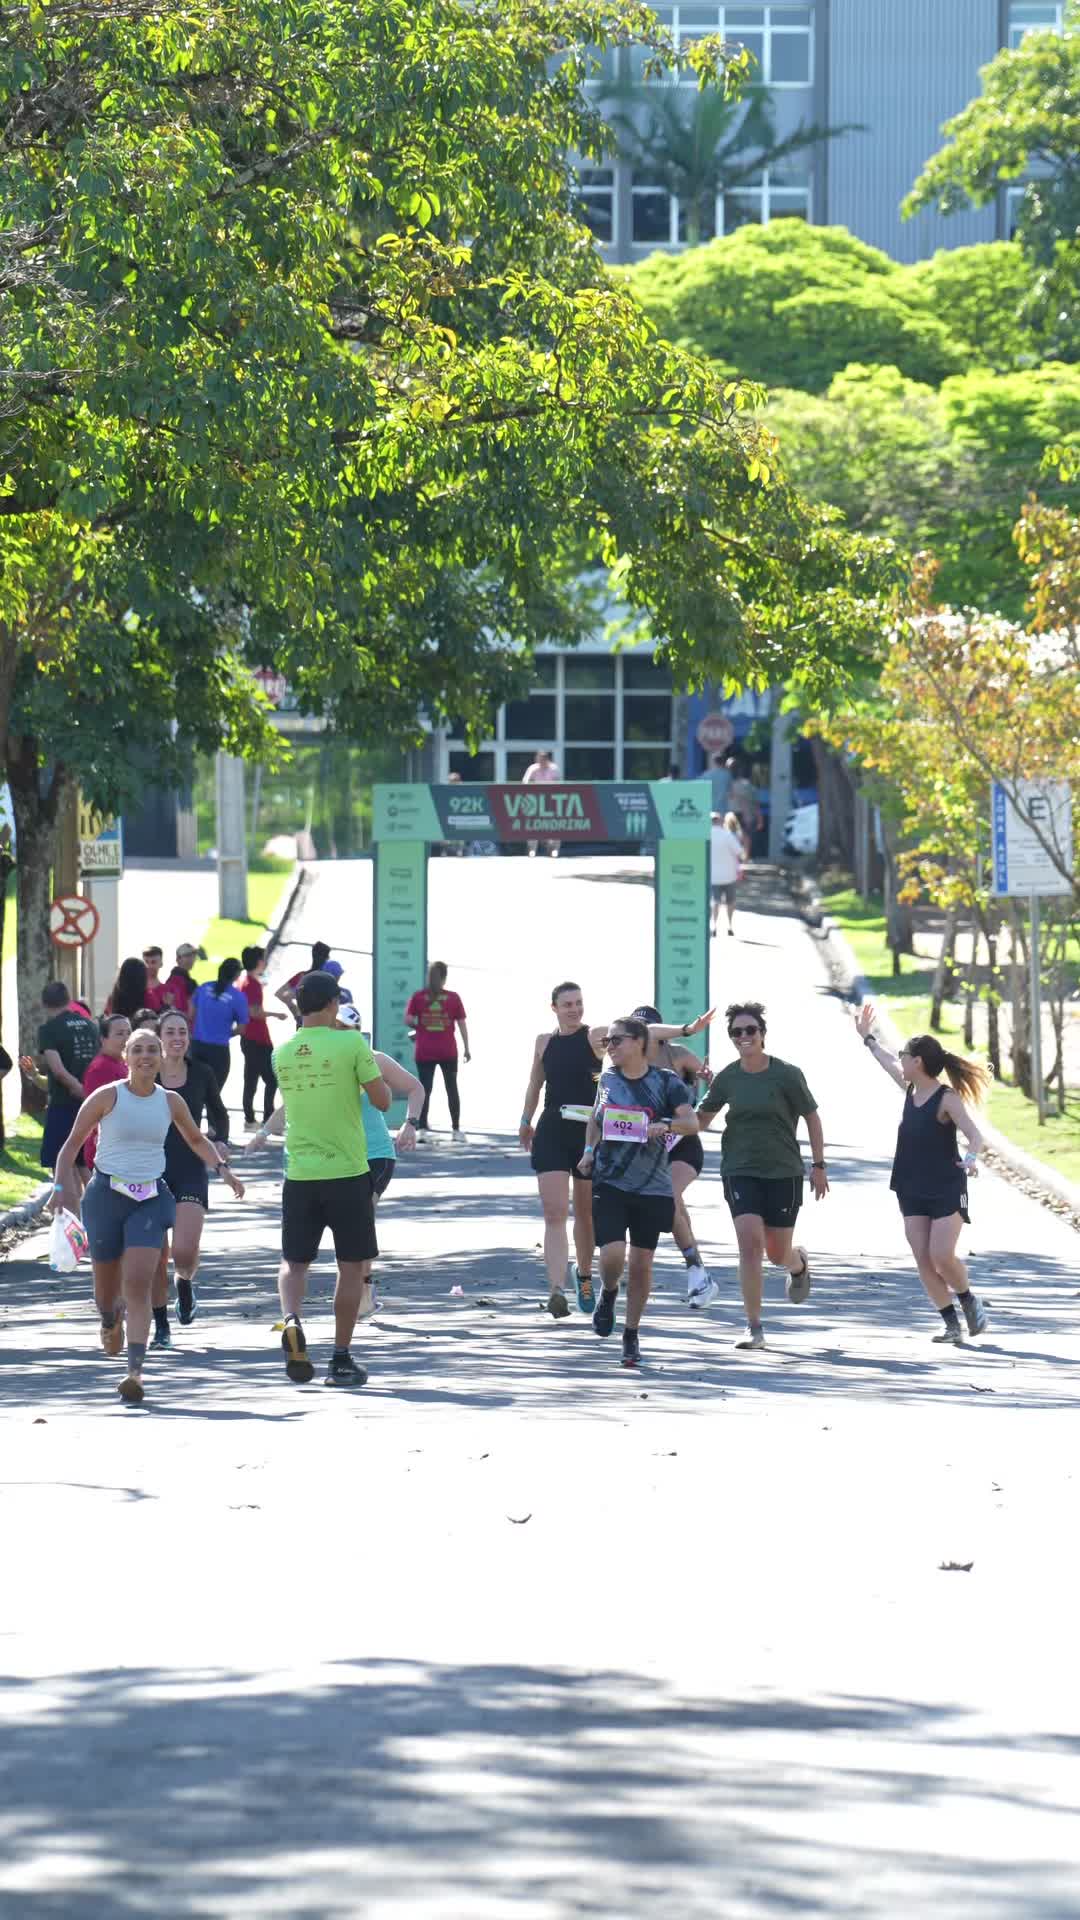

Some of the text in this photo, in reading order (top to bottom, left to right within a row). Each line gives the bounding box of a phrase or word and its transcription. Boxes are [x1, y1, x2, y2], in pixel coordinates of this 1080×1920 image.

[449, 796, 484, 813] 92K
[503, 793, 584, 817] VOLTA
[1029, 797, 1046, 820] E
[512, 818, 591, 831] A LONDRINA
[613, 1120, 633, 1130] 402
[125, 1183, 143, 1193] 02
